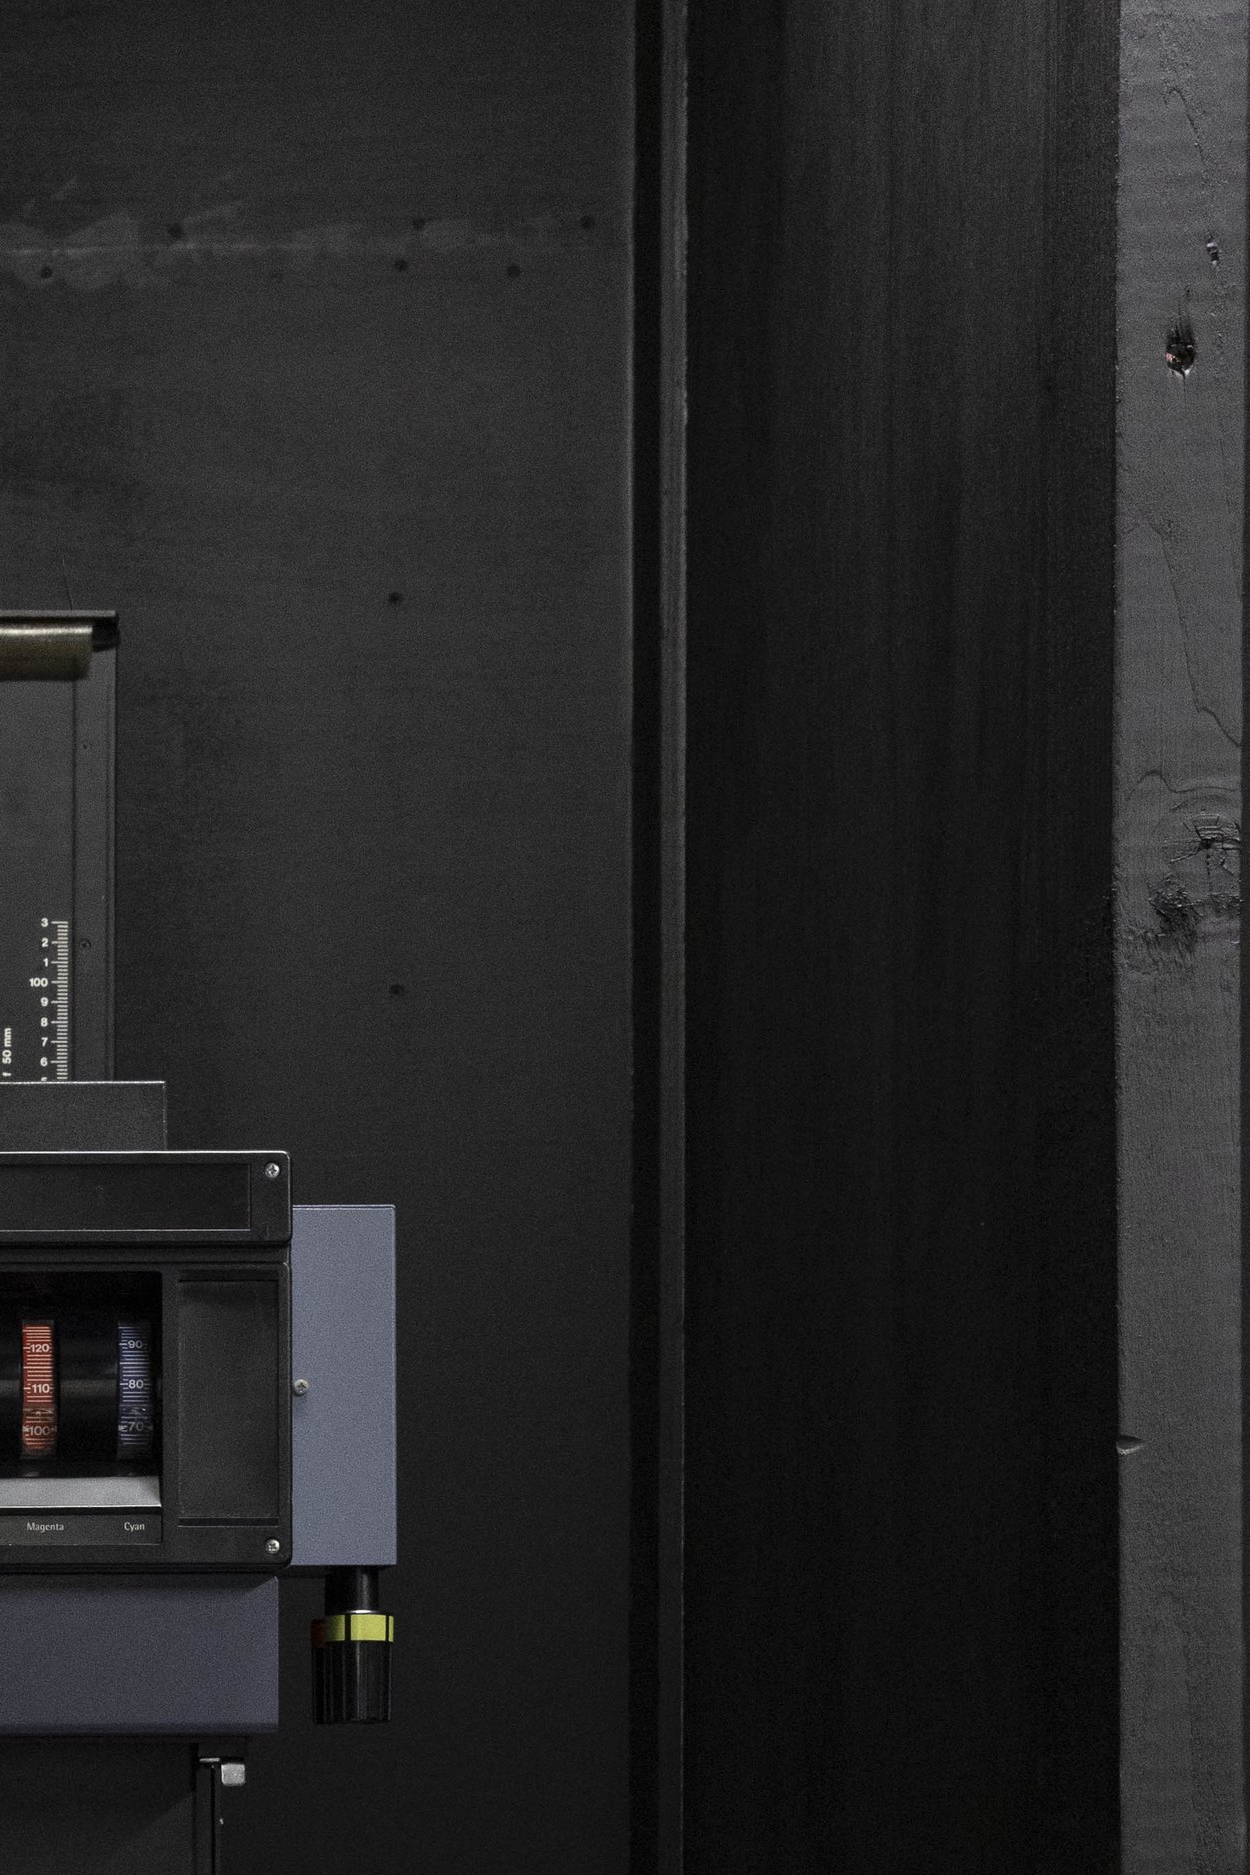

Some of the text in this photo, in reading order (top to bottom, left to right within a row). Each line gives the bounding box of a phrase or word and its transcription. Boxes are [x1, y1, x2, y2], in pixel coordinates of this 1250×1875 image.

[42, 918, 48, 927] 3
[42, 938, 48, 947] 2
[44, 958, 48, 967] 1
[30, 978, 48, 987] 100
[41, 997, 48, 1006] 9
[41, 1018, 48, 1027] 8
[4, 1028, 11, 1047] mm
[41, 1037, 48, 1046] 7
[2, 1050, 11, 1063] 50
[40, 1057, 47, 1066] 6
[30, 1343, 50, 1353] 120
[127, 1339, 143, 1350] 90
[31, 1383, 50, 1393] 110
[128, 1379, 144, 1389] 80
[28, 1425, 50, 1435] 100
[128, 1421, 144, 1431] 70
[27, 1522, 64, 1532] Magenta
[124, 1522, 144, 1532] Cyan
